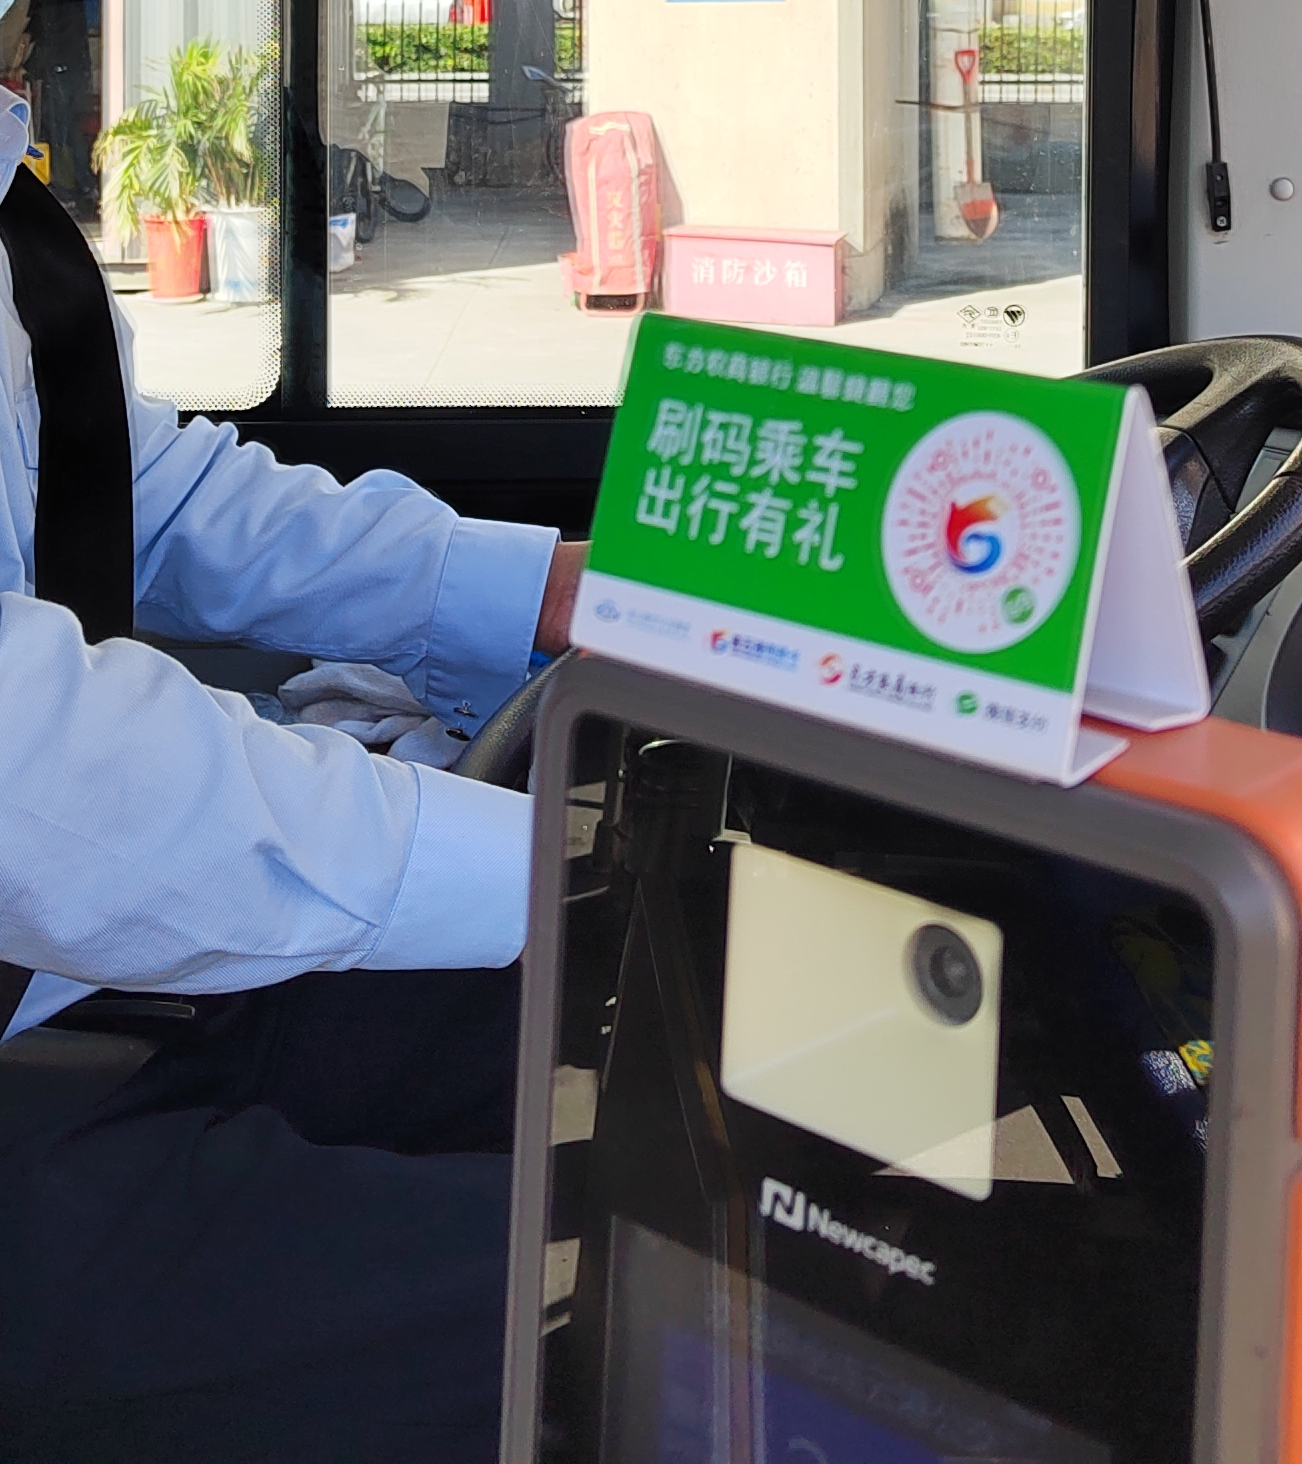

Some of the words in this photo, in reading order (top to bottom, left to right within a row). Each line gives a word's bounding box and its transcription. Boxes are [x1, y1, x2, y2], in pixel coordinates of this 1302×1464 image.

[691, 256, 809, 288] 消防沙箱
[646, 396, 866, 499] 刷码乘车
[633, 465, 848, 573] 出行有礼
[806, 1201, 937, 1286] Newcapec
